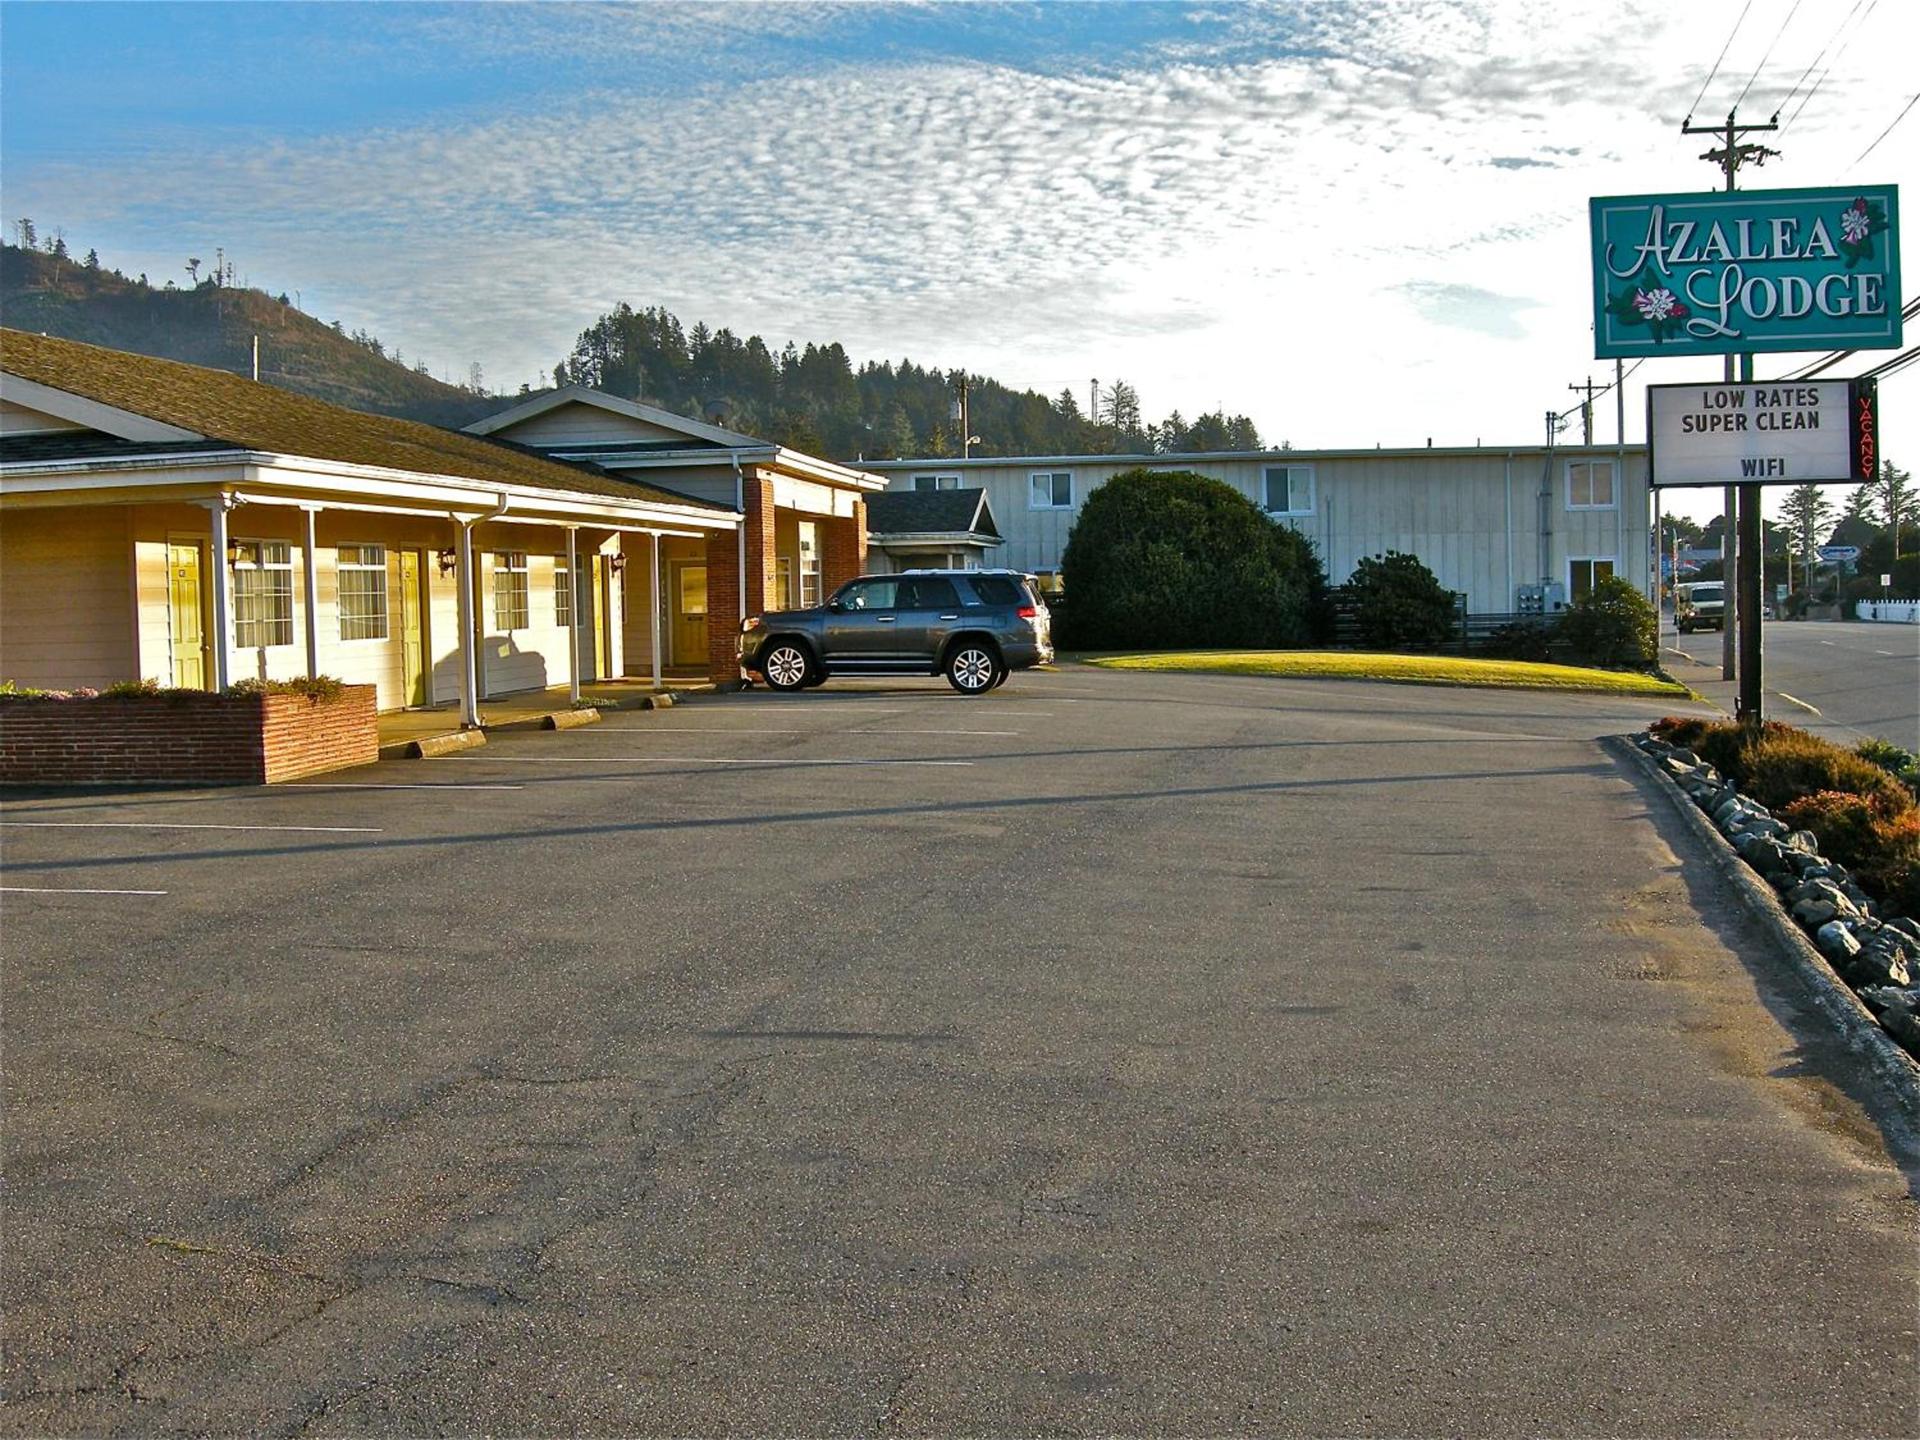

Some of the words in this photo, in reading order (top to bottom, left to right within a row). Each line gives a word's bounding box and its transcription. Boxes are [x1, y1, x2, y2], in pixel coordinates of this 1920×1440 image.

[1606, 204, 1838, 277] AZALEA
[1686, 263, 1886, 337] LODGE
[1682, 413, 1748, 433] SUPER
[1756, 411, 1819, 431] CLEAN
[1703, 390, 1745, 409] LOW
[1755, 388, 1819, 408] RATES
[1859, 397, 1874, 478] VACANCY
[1740, 458, 1785, 477] WIFI
